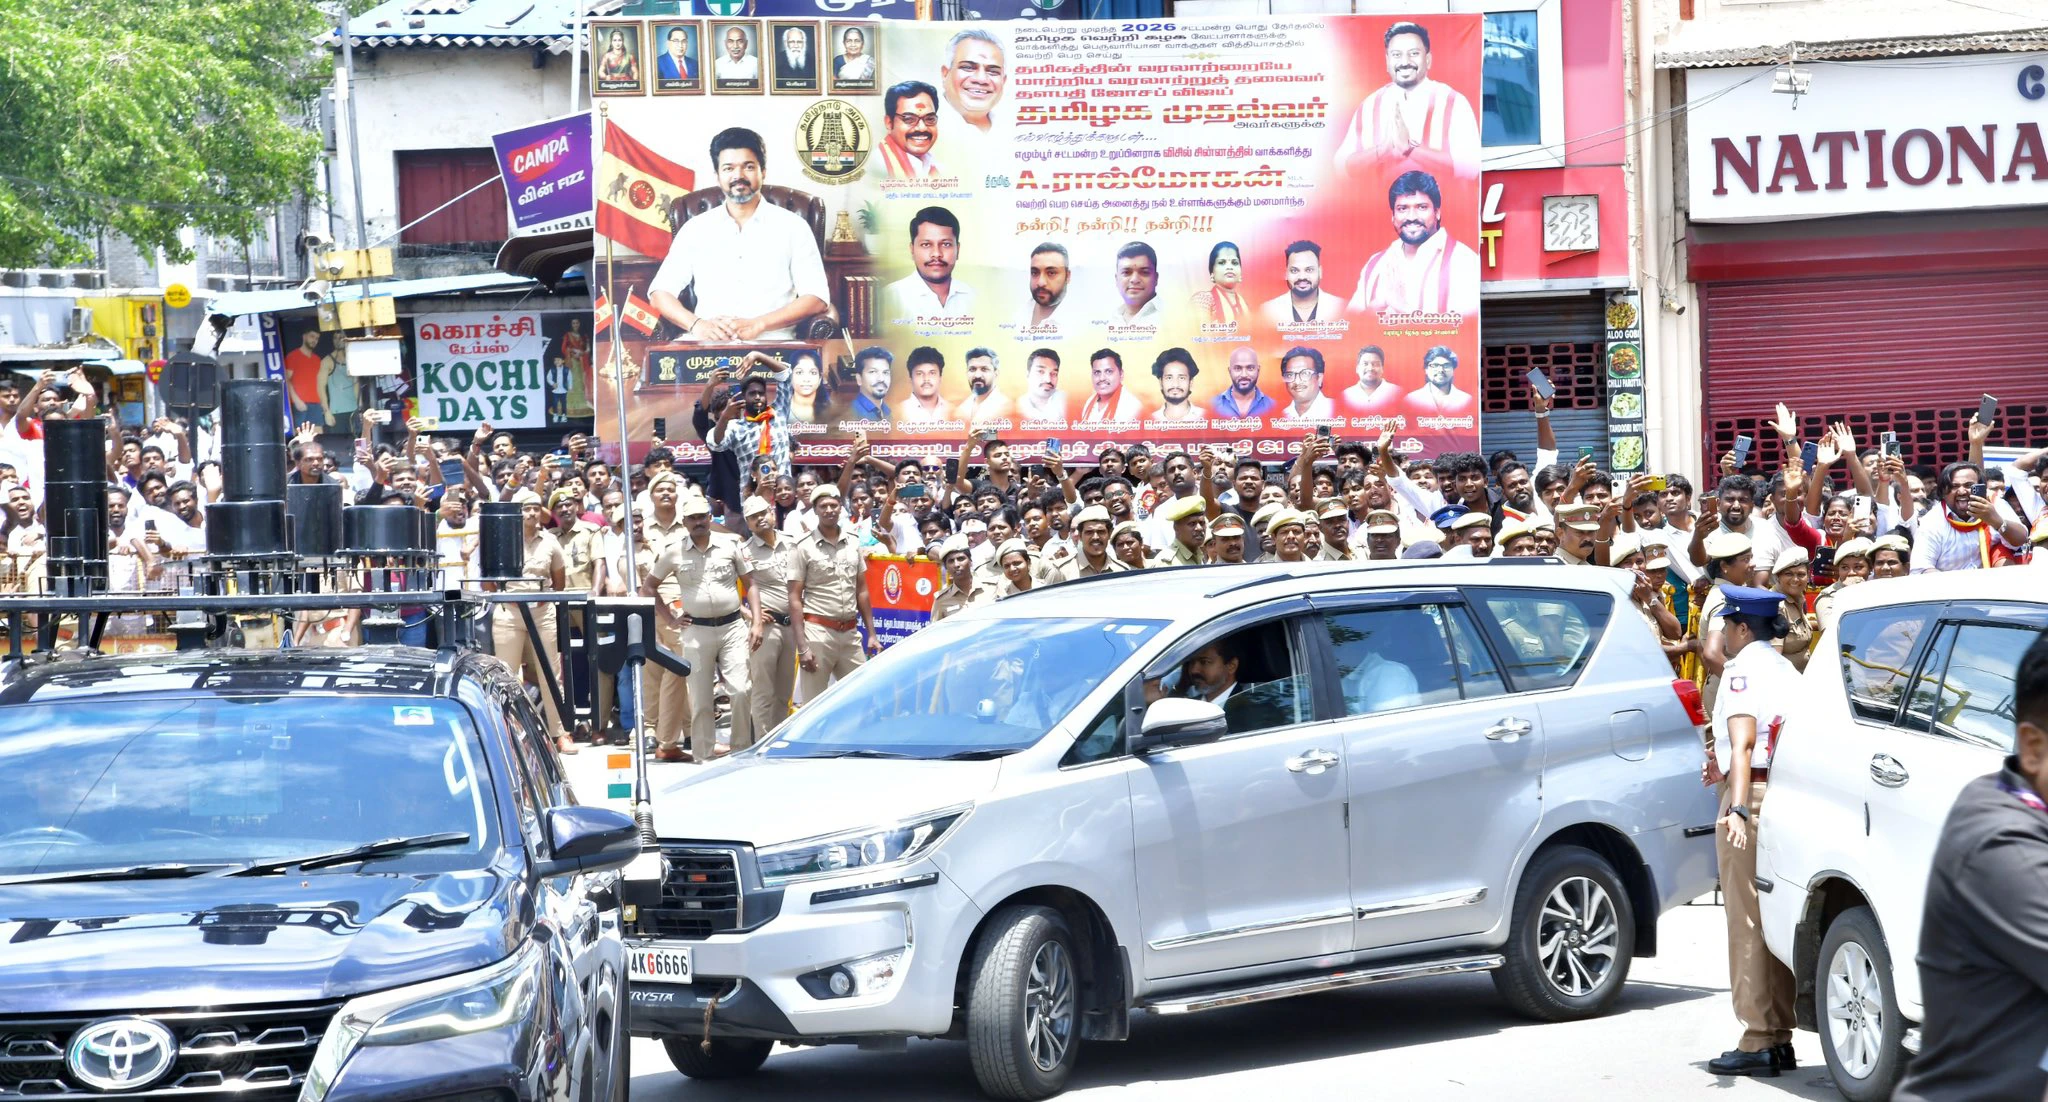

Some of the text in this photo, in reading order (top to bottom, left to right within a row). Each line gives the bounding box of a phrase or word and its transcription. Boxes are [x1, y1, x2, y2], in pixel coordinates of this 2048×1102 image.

[1122, 23, 1177, 32] 2026
[1181, 23, 1231, 32] சட்டமன்ற
[1235, 23, 1268, 31] பொது
[1014, 34, 1076, 44] தமிழக
[1080, 33, 1140, 43] வெற்றி
[1144, 33, 1188, 42] கழக
[1015, 52, 1053, 60] வெற்றி
[1057, 51, 1082, 60] பெற
[1138, 61, 1293, 73] வரலாற்றையே
[1015, 72, 1325, 87] மாற்றிய வரலாற்றுத் தலைவர்
[1014, 86, 1235, 99] தளபதி ஜோசப் விஜய்
[1015, 97, 1329, 127] தமிழக முதல்வர்
[1233, 119, 1326, 129] அவர்களுக்கு
[514, 136, 570, 173] CAMPA
[1054, 148, 1098, 160] சட்டமன்ற
[1100, 148, 1161, 160] உறுப்பினராக
[1163, 146, 1193, 158] விசில்
[1254, 145, 1313, 158] வாக்களித்து
[518, 169, 586, 206] வின் FIZZ
[1015, 197, 1048, 209] வெற்றி
[1049, 197, 1069, 209] பெற
[1101, 196, 1151, 208] அனைத்து
[1015, 216, 1069, 235] நன்றி!
[420, 315, 536, 340] கொச்சி
[1607, 330, 1624, 340] ALOO
[449, 340, 510, 355] டேய்ஸ்
[420, 359, 541, 394] KOCHI
[437, 395, 529, 423] DAYS
